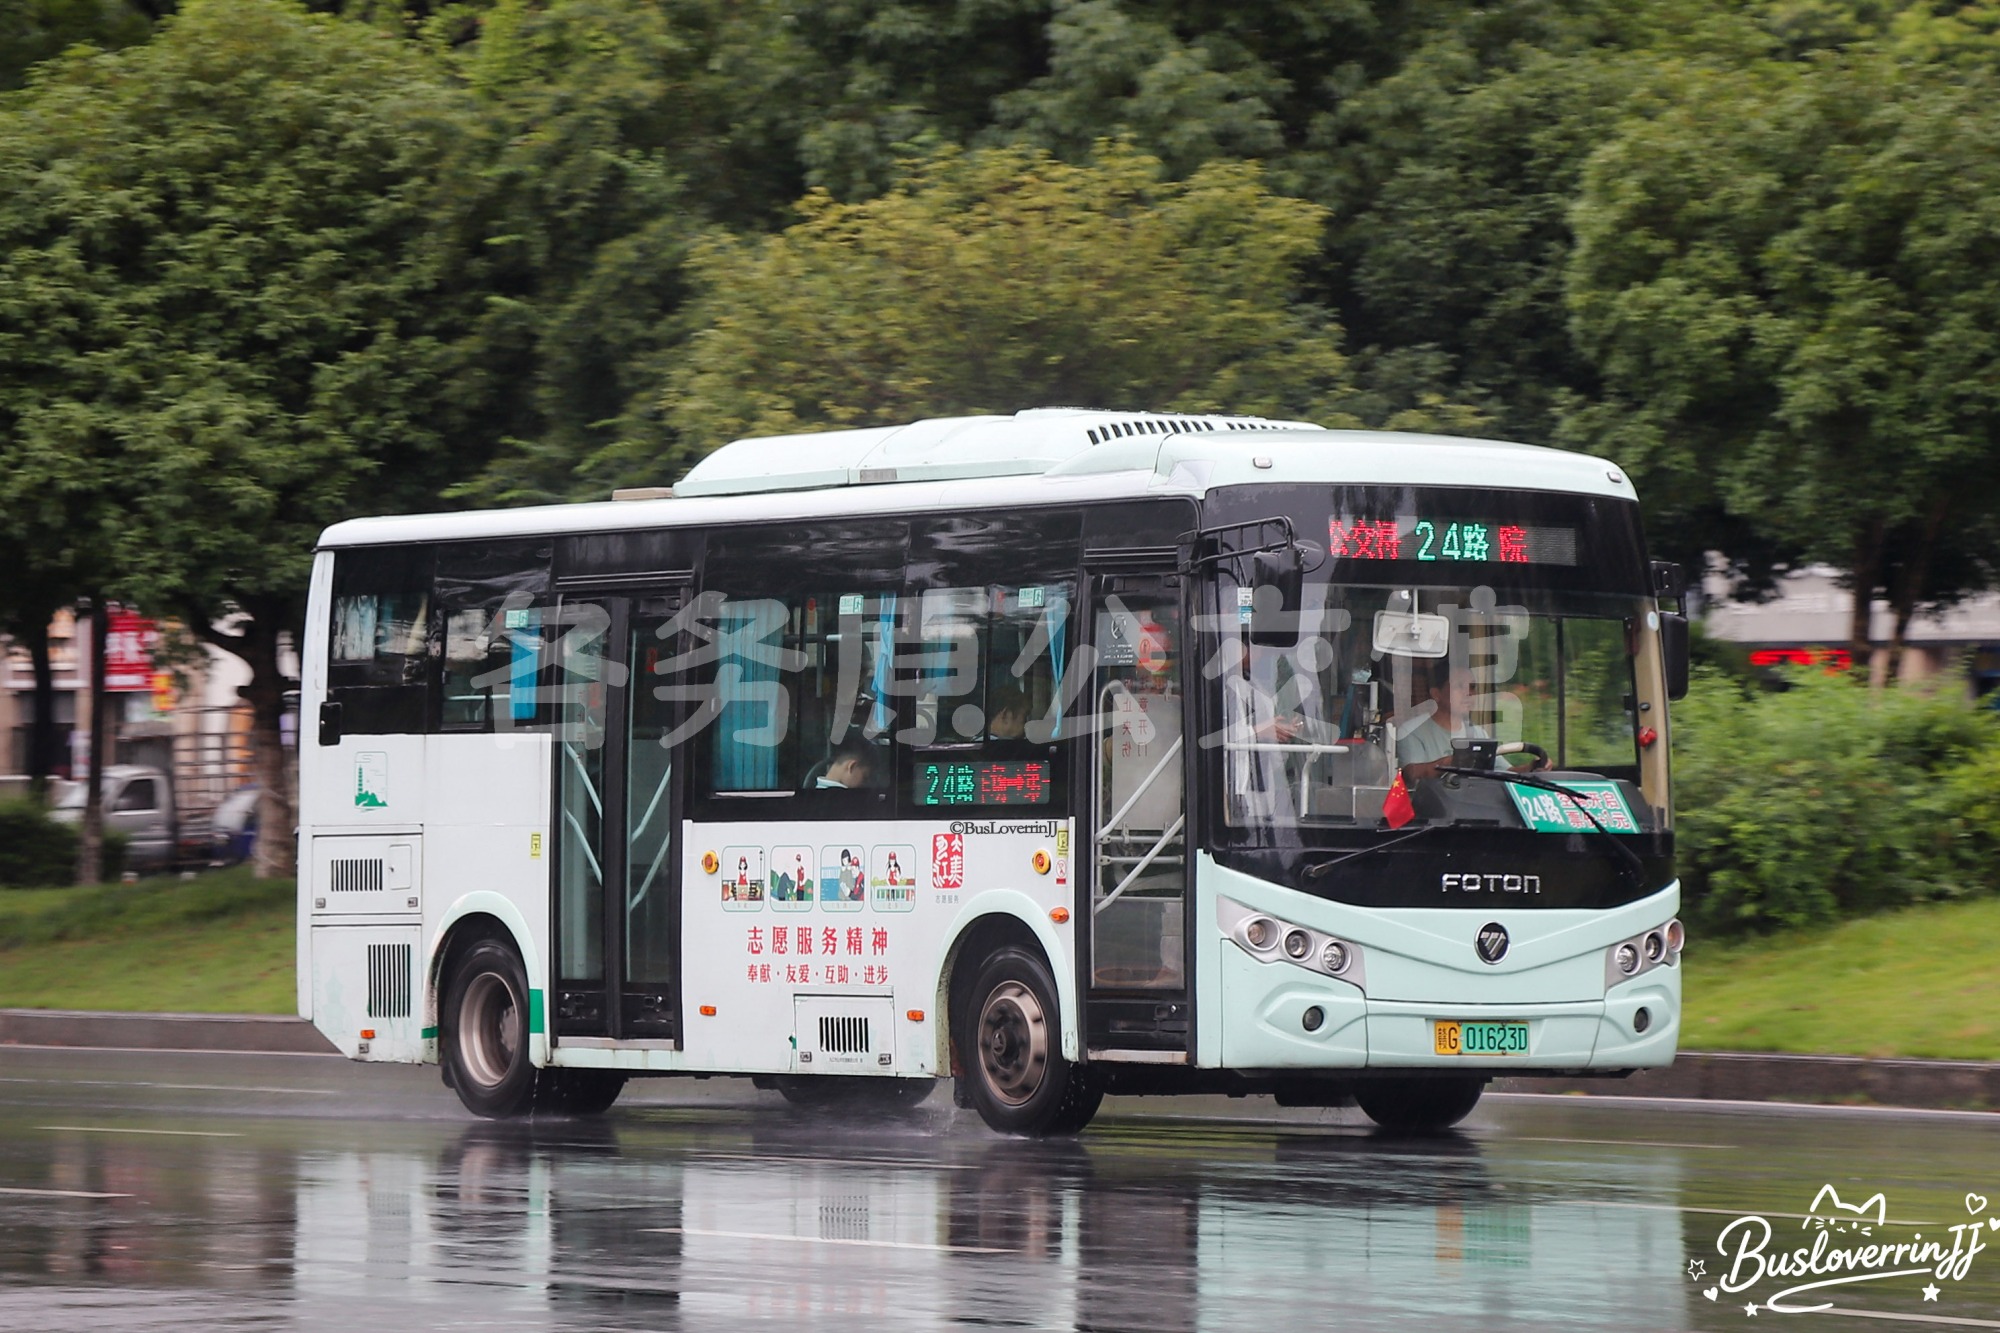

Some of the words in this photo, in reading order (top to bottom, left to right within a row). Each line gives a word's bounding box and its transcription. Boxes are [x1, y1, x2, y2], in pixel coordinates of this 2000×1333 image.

[1415, 521, 1489, 561] 24路
[926, 765, 975, 804] 24路
[1522, 794, 1564, 824] 24路
[1442, 874, 1541, 893] FOTON
[747, 926, 888, 955] 志愿服务精神
